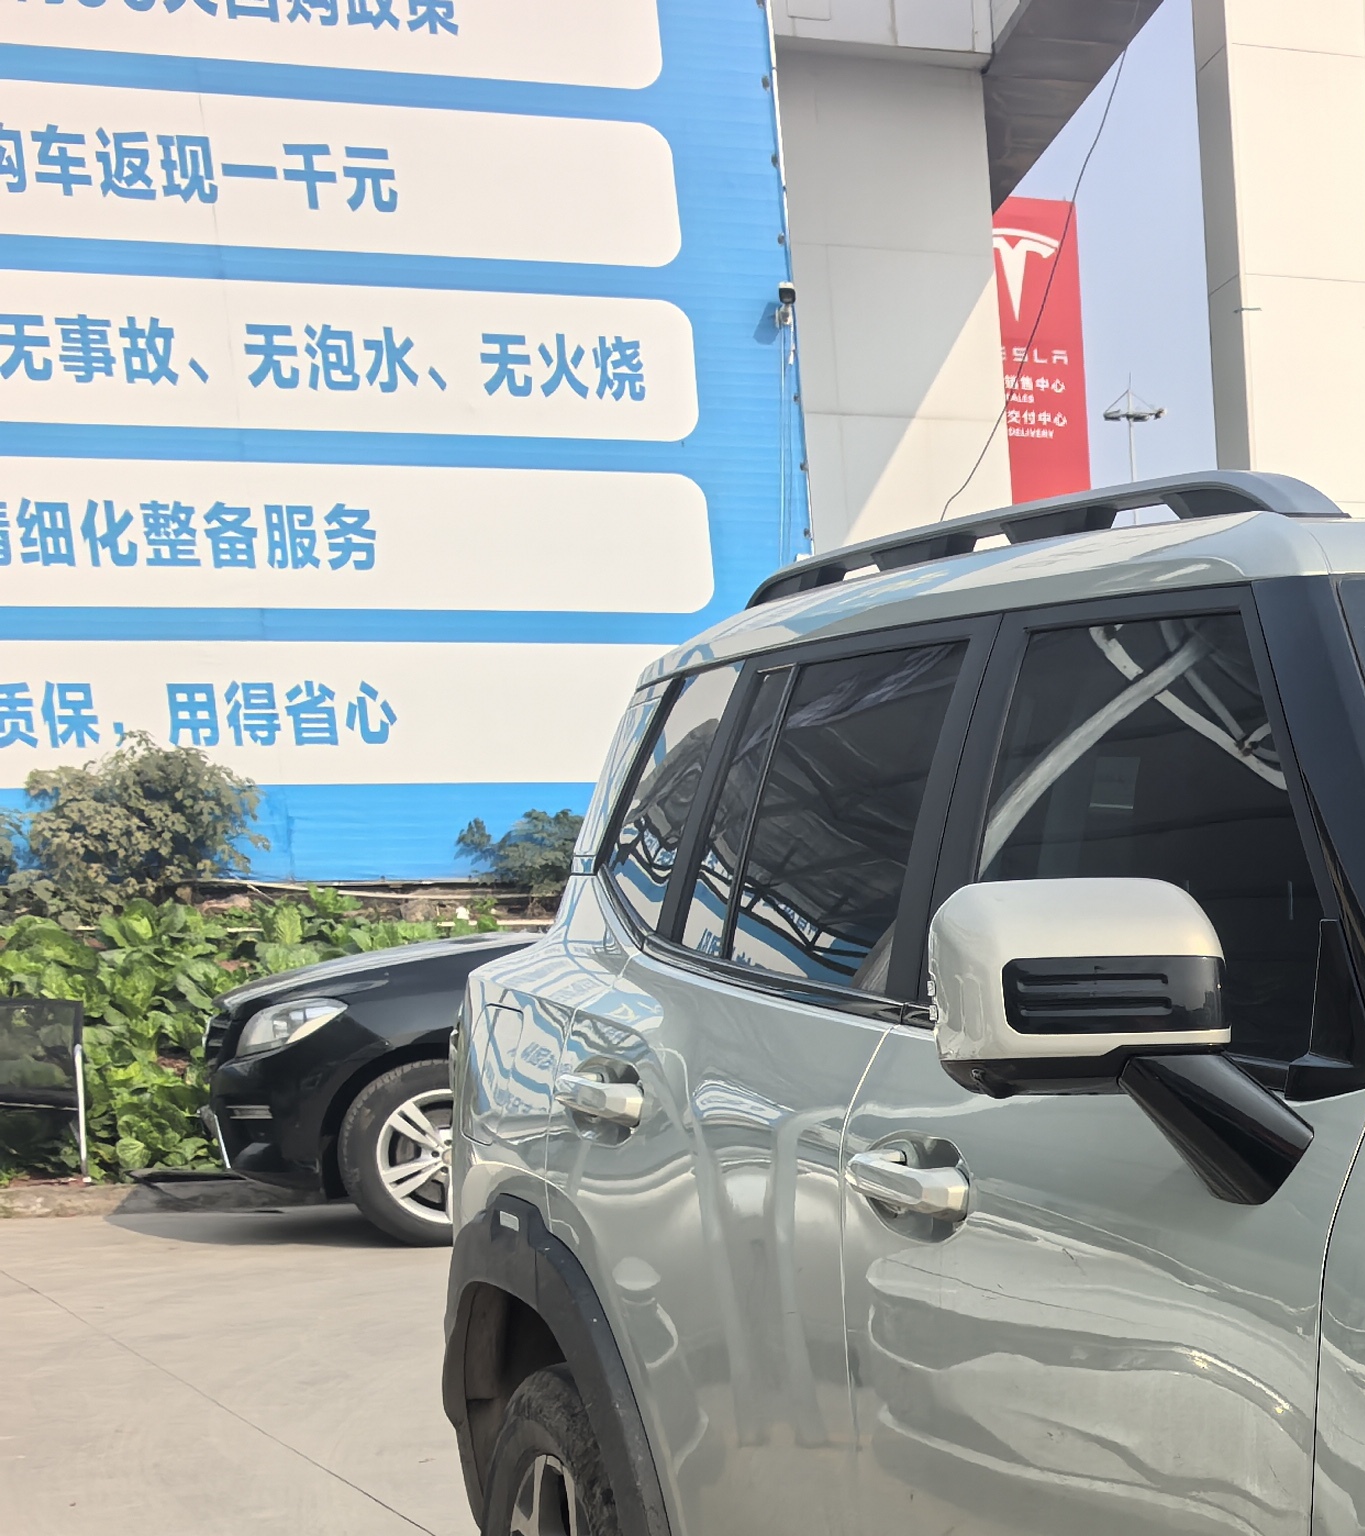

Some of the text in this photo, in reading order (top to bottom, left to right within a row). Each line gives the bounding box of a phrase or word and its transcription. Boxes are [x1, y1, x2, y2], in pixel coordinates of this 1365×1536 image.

[0, 313, 647, 402] 无事故、无泡水、无火烧
[1007, 409, 1068, 427] 交付中心
[0, 496, 378, 571] 细化整备服务
